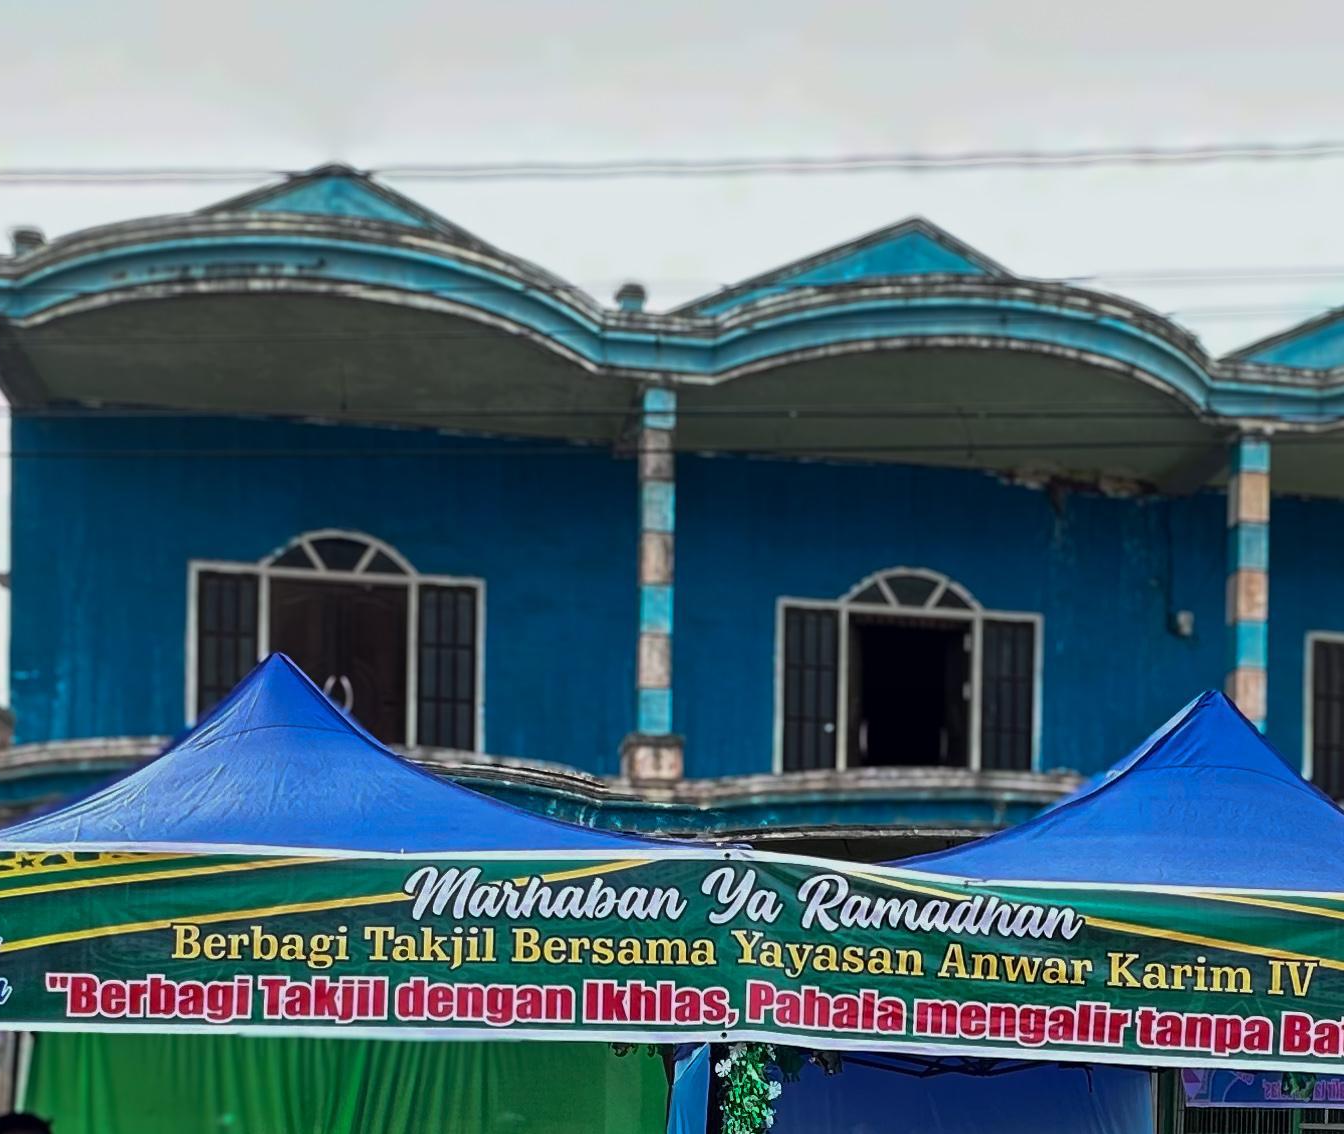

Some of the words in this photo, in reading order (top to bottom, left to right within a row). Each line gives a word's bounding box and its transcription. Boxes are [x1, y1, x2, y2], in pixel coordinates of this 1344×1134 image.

[403, 866, 688, 922] Marhaban
[701, 866, 783, 924] Ya
[797, 872, 1086, 941] Ramadhan
[171, 922, 351, 968] Berbagi
[364, 926, 497, 970] Takjil
[511, 929, 717, 966] Bersama
[729, 929, 924, 979] Yayasan
[937, 943, 1093, 988] Anwar
[1107, 951, 1254, 996] Karim
[1267, 958, 1321, 998] IV
[47, 974, 253, 1020] "Berbagi
[257, 977, 388, 1022] Takjil
[395, 979, 576, 1026] dengan
[582, 980, 739, 1028] Ikhlas,
[746, 980, 903, 1034] Pahala
[914, 997, 1129, 1047] mengalir
[1136, 1007, 1272, 1056] tanpa
